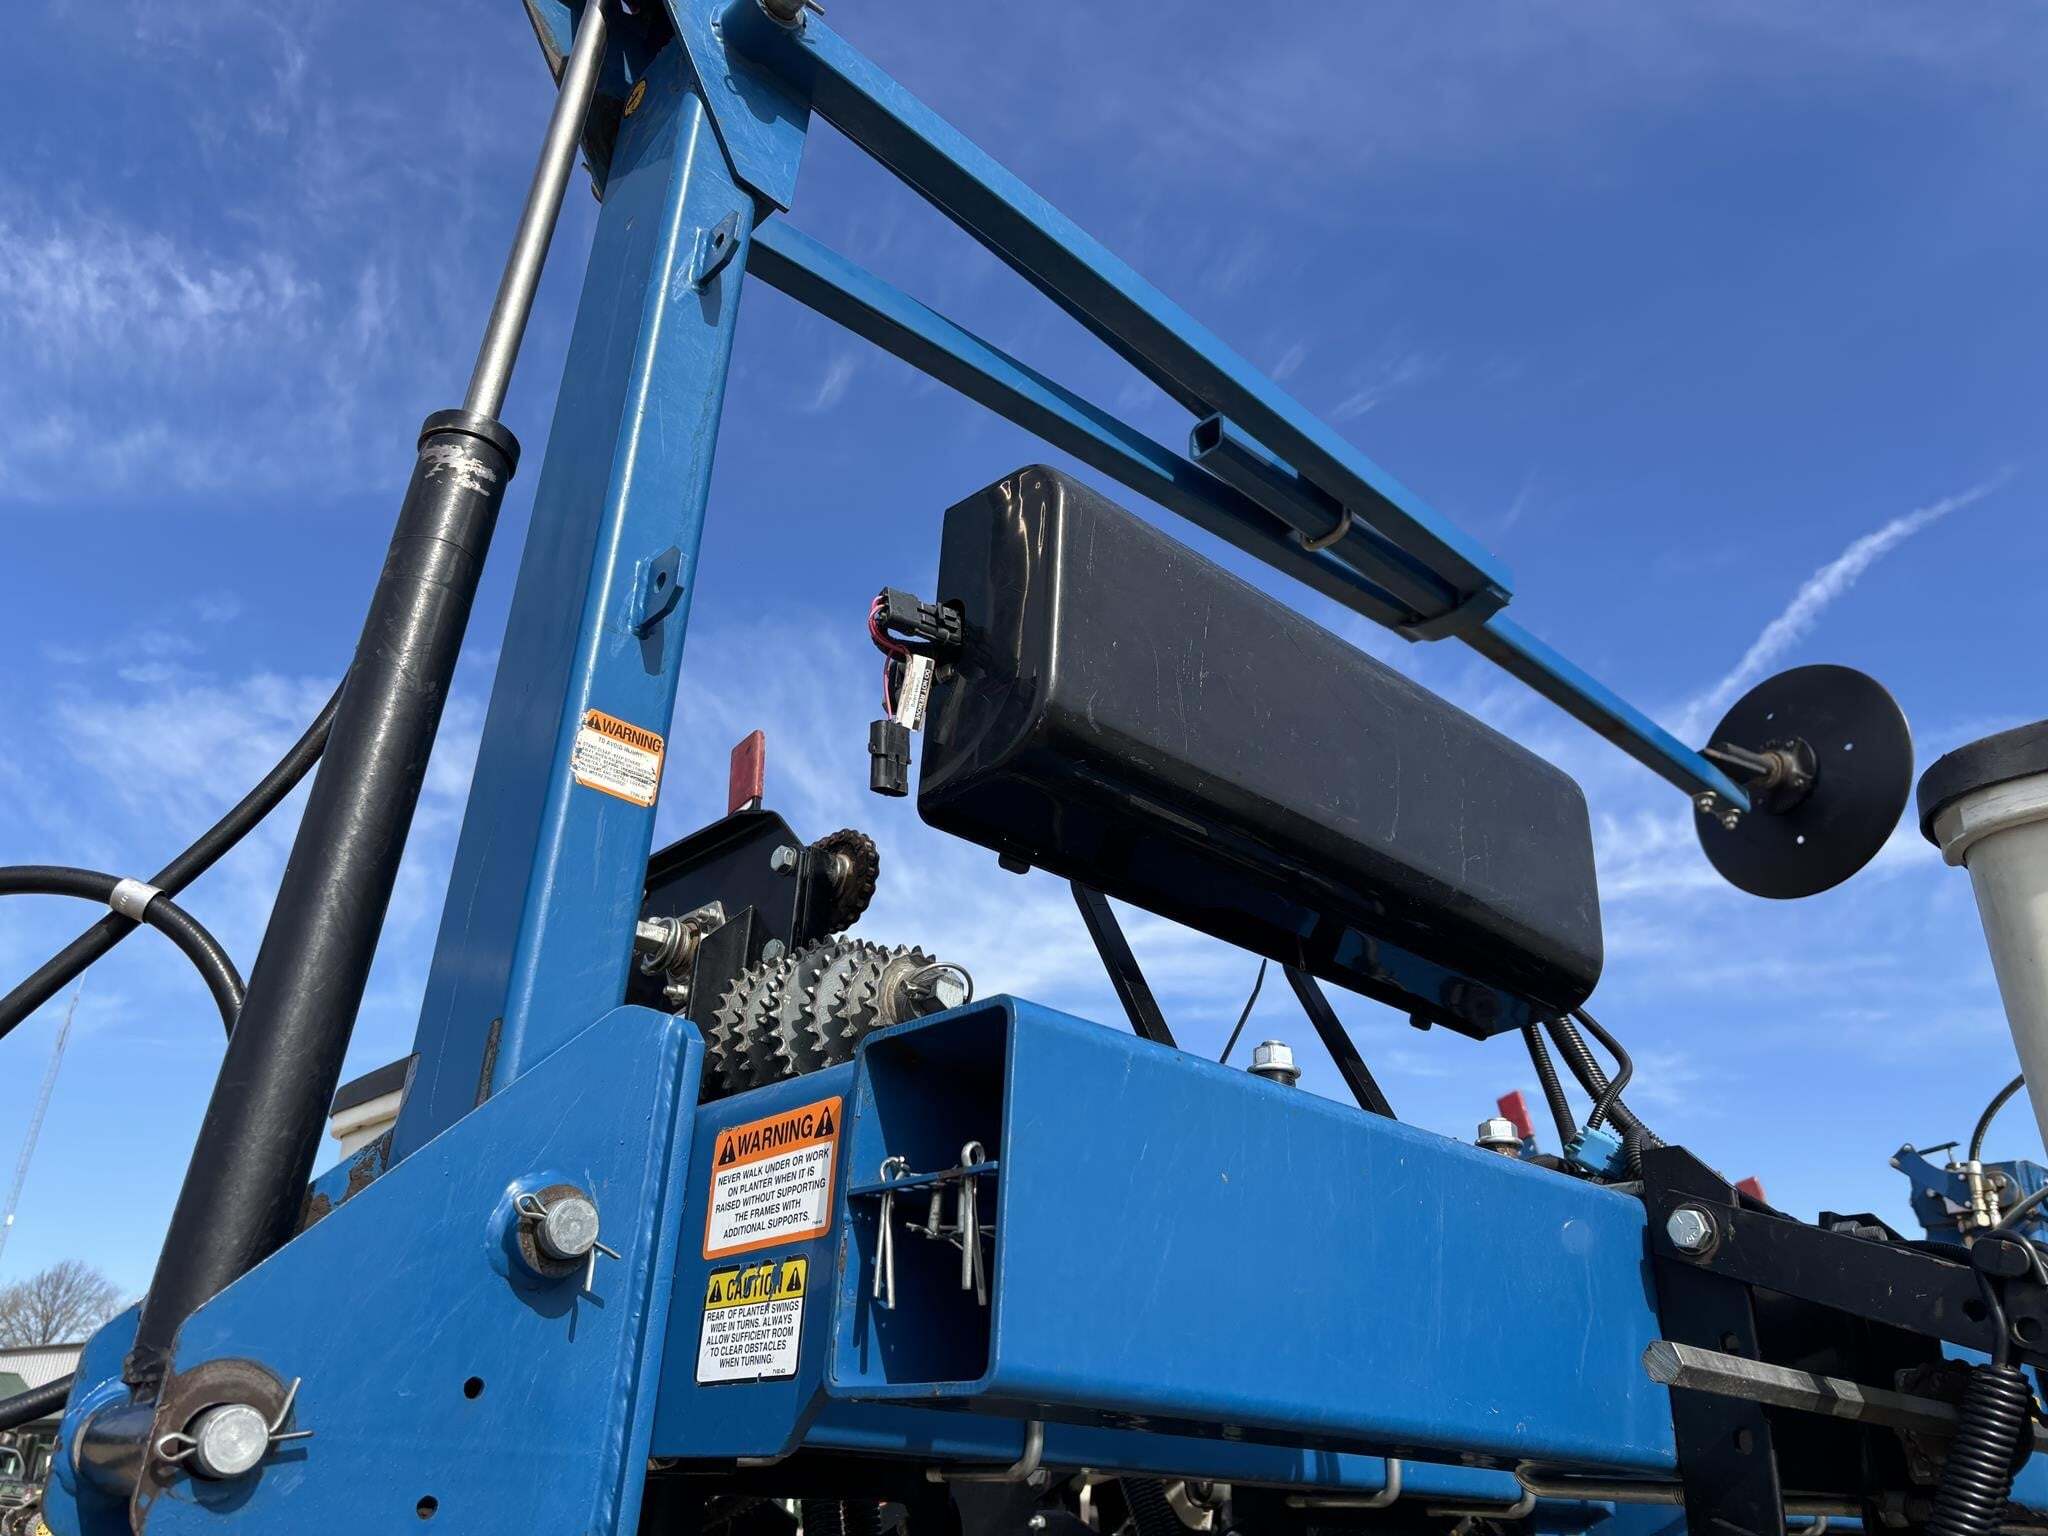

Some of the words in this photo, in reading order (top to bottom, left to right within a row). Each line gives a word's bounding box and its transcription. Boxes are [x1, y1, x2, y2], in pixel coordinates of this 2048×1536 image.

[924, 669, 931, 679] DO
[602, 718, 661, 752] WARNING
[738, 1114, 813, 1157] WARNING
[718, 1172, 741, 1187] NEVER
[742, 1166, 763, 1180] WALK
[765, 1160, 790, 1175] UNDER
[792, 1155, 803, 1165] OR
[805, 1148, 829, 1163] WORK
[727, 1186, 738, 1197] ON
[740, 1178, 772, 1195] PLANTER
[774, 1171, 796, 1184] WHEN
[798, 1168, 805, 1179] IT
[807, 1166, 815, 1176] IS
[715, 1200, 741, 1214] RAISED
[742, 1191, 774, 1207] WITHOUT
[776, 1178, 826, 1199] SUPPORTING
[735, 1211, 748, 1222] THE
[750, 1203, 780, 1219] FRAMES
[782, 1199, 801, 1211] WITH
[723, 1221, 766, 1239] ADDITIONAL
[767, 1211, 809, 1229] SUPPORTS.
[706, 1311, 724, 1322] REAR
[727, 1309, 737, 1319] OF
[738, 1304, 770, 1318] PLANTER
[771, 1301, 799, 1314] SWINGS
[710, 1322, 727, 1333] WIDE
[728, 1321, 735, 1331] IN
[737, 1318, 760, 1330] TURNS.
[762, 1314, 792, 1327] ALWAYS
[706, 1334, 729, 1346] ALLOW
[731, 1329, 770, 1343] SUFFICIENT
[771, 1326, 794, 1338] ROOM
[710, 1347, 719, 1357] TO
[720, 1345, 743, 1356] CLEAR
[744, 1340, 787, 1354] OBSTACLES
[719, 1357, 739, 1368] WHEN
[740, 1354, 773, 1367] TURNING.
